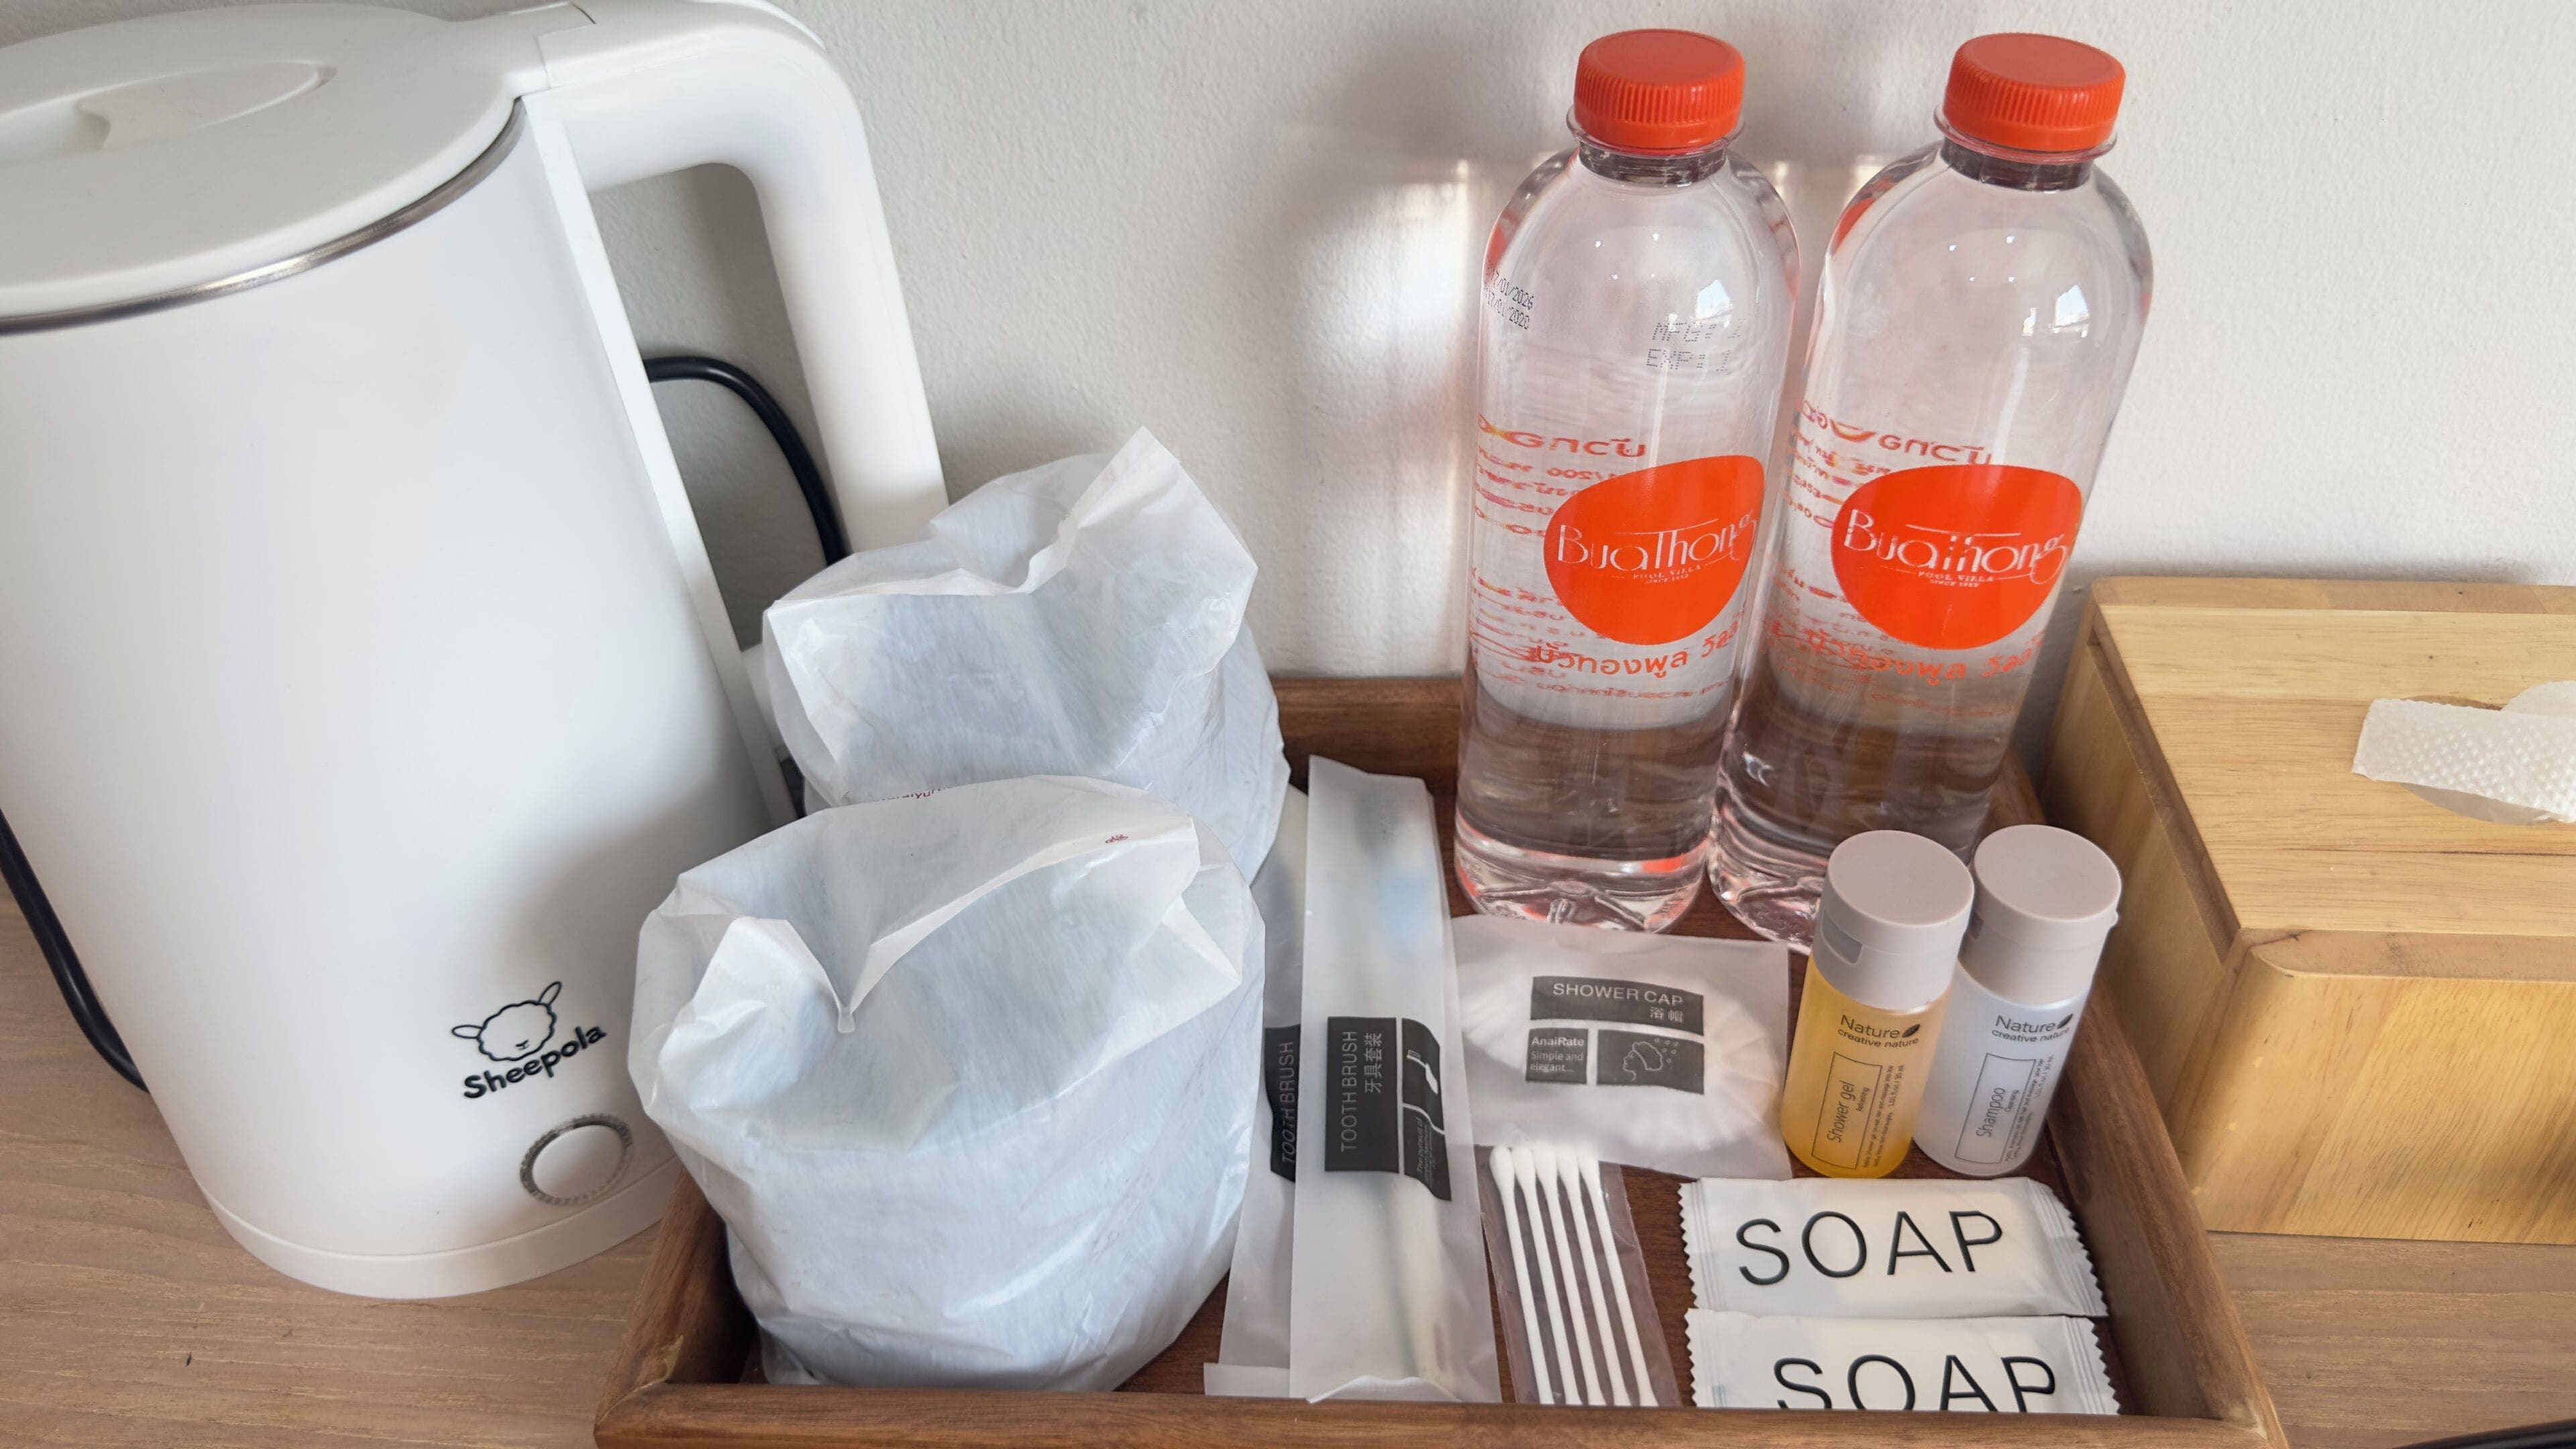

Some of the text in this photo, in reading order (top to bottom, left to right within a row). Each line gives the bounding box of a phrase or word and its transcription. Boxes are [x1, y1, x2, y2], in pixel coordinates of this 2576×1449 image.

[1558, 509, 1758, 571] BuaThong
[1552, 982, 1684, 1007] SHOWER CAP
[1837, 1028, 1919, 1048] creative nature
[1839, 1014, 1900, 1039] Nature
[1991, 1026, 2070, 1042] creative nature
[1995, 1014, 2056, 1034] Nature
[464, 1026, 607, 1099] Sheepola
[1530, 1051, 1584, 1063] Simple and
[1279, 1040, 1297, 1164] TOOTH BRUSH
[1341, 1030, 1358, 1152] TOOTH BRUSH
[1826, 1079, 1856, 1143] Shower gel
[1976, 1086, 2006, 1138] Shampoo
[1735, 1210, 2002, 1286] SOAP
[1773, 1354, 2056, 1413] SOAP
